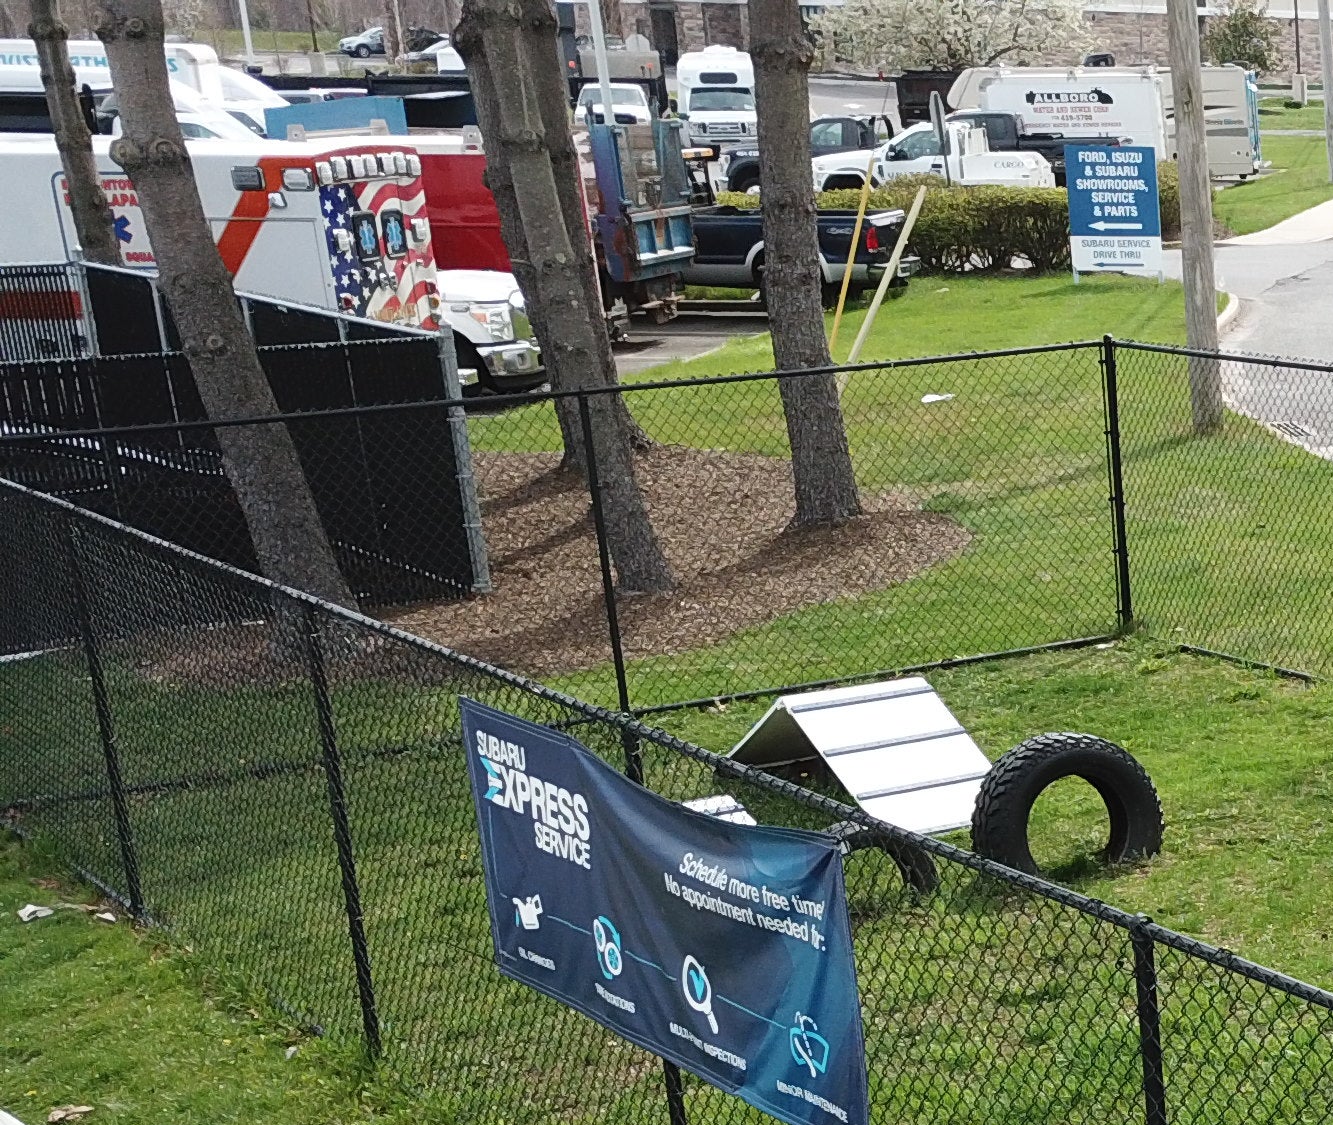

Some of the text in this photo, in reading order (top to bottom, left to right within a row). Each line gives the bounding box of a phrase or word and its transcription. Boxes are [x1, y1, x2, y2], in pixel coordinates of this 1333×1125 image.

[1034, 93, 1099, 103] ALLBORO
[1078, 151, 1143, 165] FORD, ISUZU
[1084, 165, 1139, 177] & SUBARU
[1076, 178, 1149, 193] SHOWROOMS,
[1091, 192, 1136, 204] SERVICE
[1093, 205, 1138, 217] & PARTS
[1081, 240, 1151, 248] SUBARU SERVICE
[1093, 250, 1141, 259] DRIVE THRU
[476, 730, 526, 772] SUBARU
[479, 757, 591, 841] EXPRESS
[534, 822, 591, 870] SERVICE
[679, 852, 728, 891] Schedule
[728, 877, 759, 903] more
[762, 885, 790, 911] free
[664, 872, 680, 897] No
[682, 885, 757, 926] appointment
[757, 913, 809, 942] needed
